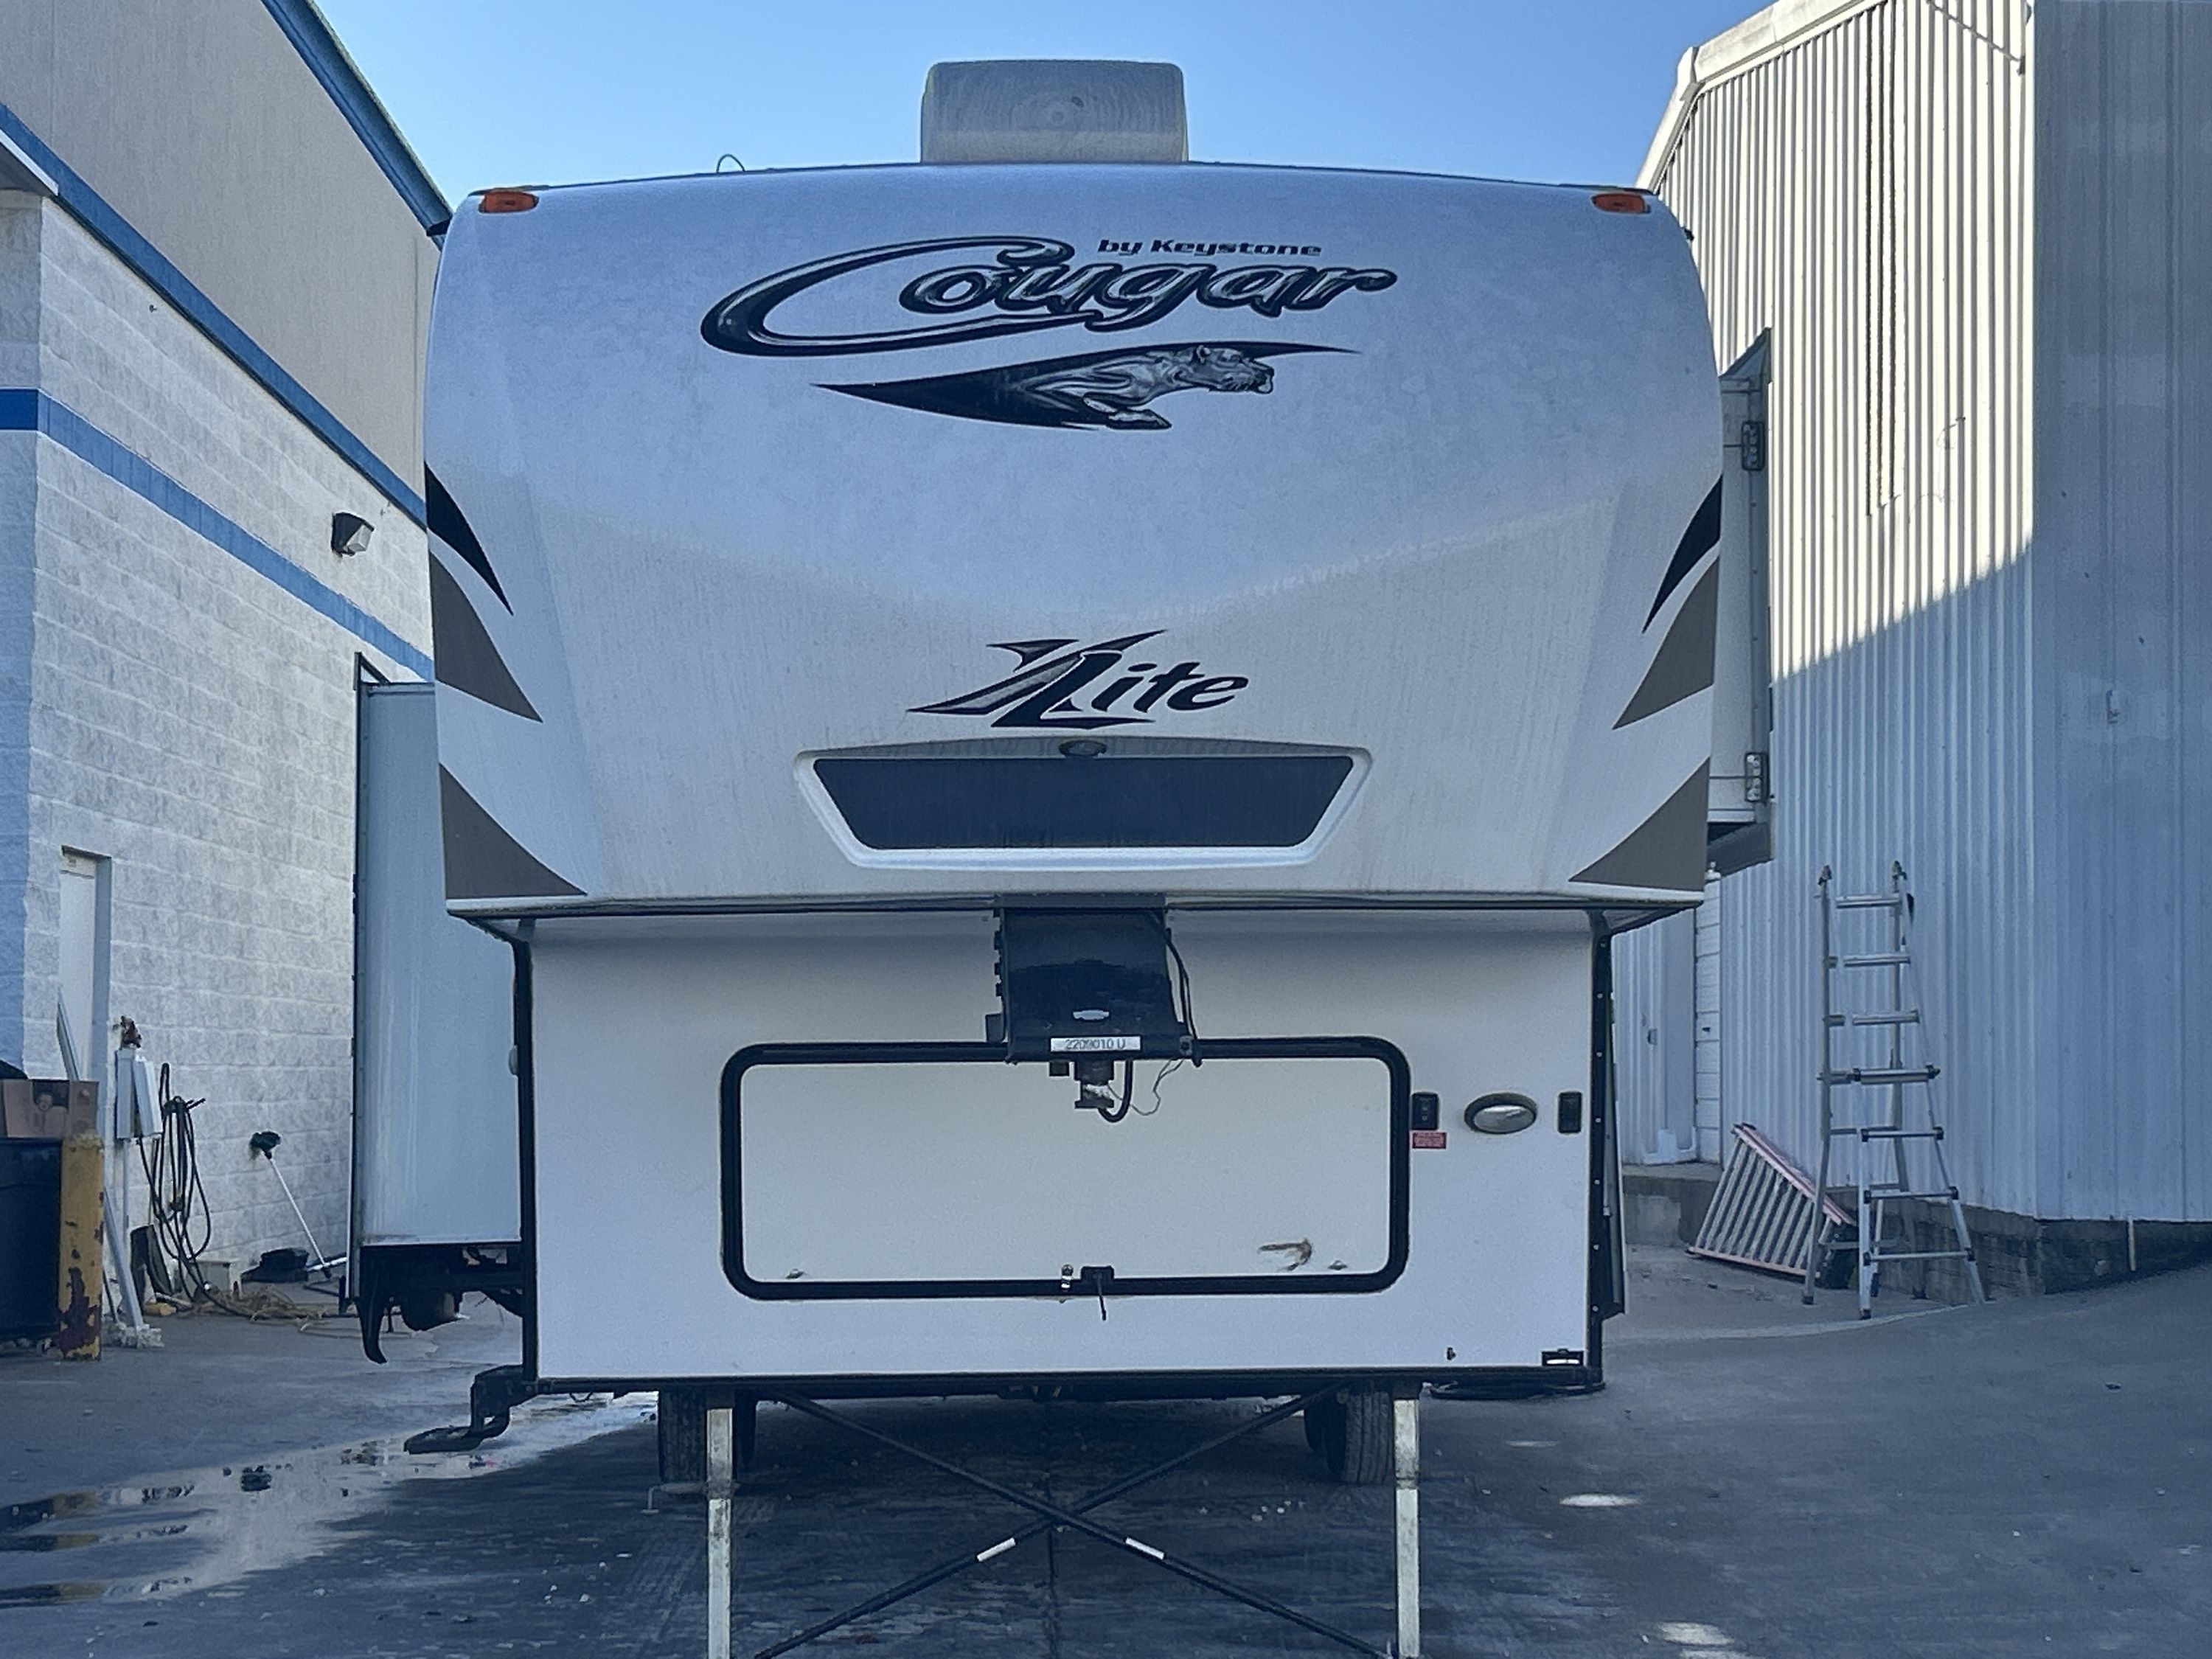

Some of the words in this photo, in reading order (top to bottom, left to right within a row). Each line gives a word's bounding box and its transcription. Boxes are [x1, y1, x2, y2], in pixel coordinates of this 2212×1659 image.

[1097, 239, 1143, 256] by
[1150, 239, 1322, 256] Keystone
[700, 236, 1397, 356] Cougar
